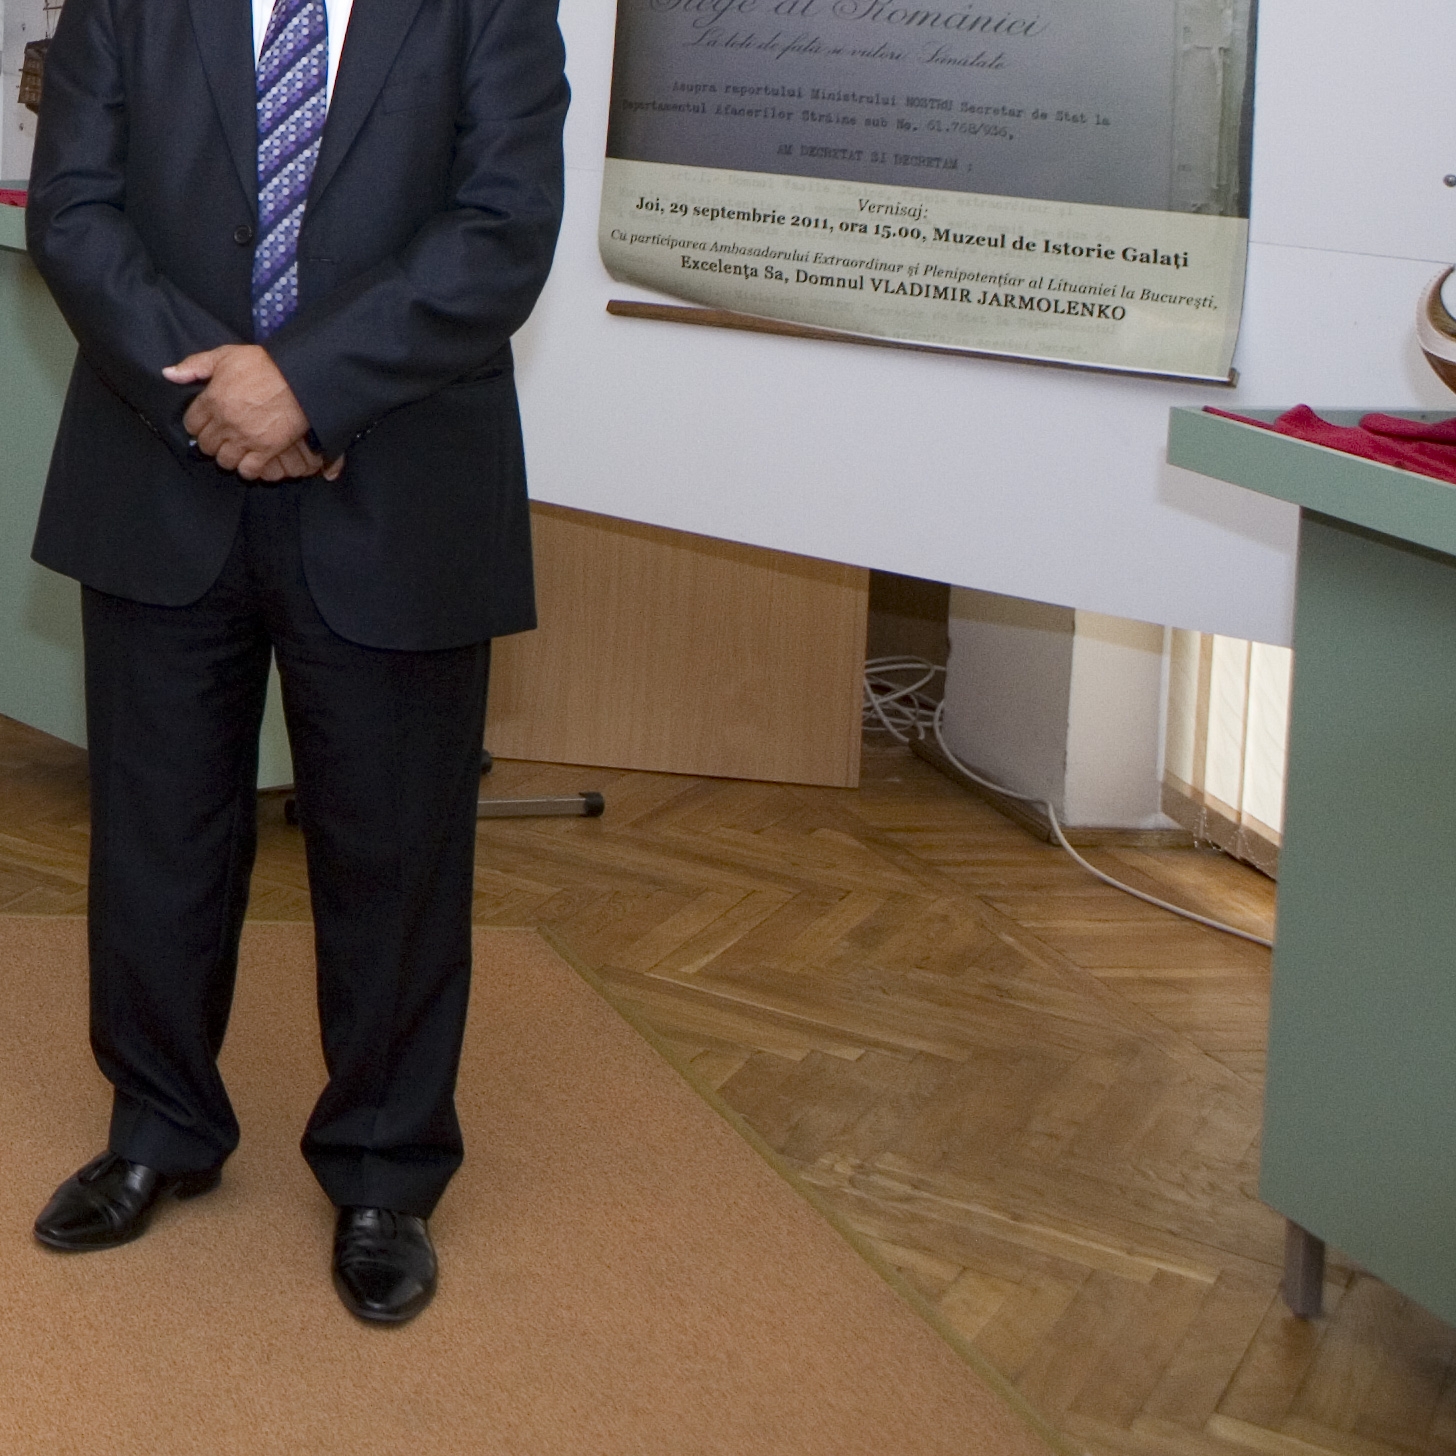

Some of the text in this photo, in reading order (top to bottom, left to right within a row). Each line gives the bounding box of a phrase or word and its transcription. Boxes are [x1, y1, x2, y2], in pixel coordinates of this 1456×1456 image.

[960, 101, 1024, 118] Secretar
[635, 196, 665, 214] Joi,
[669, 201, 689, 216] 29
[692, 204, 787, 226] septembrie
[790, 214, 835, 234] 2011,
[839, 220, 868, 234] ora
[874, 223, 928, 243] 15.00,
[932, 226, 1006, 249] Muzeul
[1011, 235, 1037, 253] de
[1043, 238, 1116, 260] Istorie
[858, 197, 929, 222] Vernisaj:
[610, 228, 628, 242] Cu
[629, 230, 707, 250] participarea
[708, 240, 810, 264] Ambasadorului
[812, 251, 904, 274] Extraordinar
[1028, 276, 1044, 290] al
[1046, 277, 1117, 298] Lituaniei
[1120, 284, 1137, 300] la
[763, 264, 790, 284] Sa,
[795, 268, 864, 291] Domnul
[870, 276, 973, 304] VLADIMIR
[976, 289, 1127, 322] JARMOLENKO
